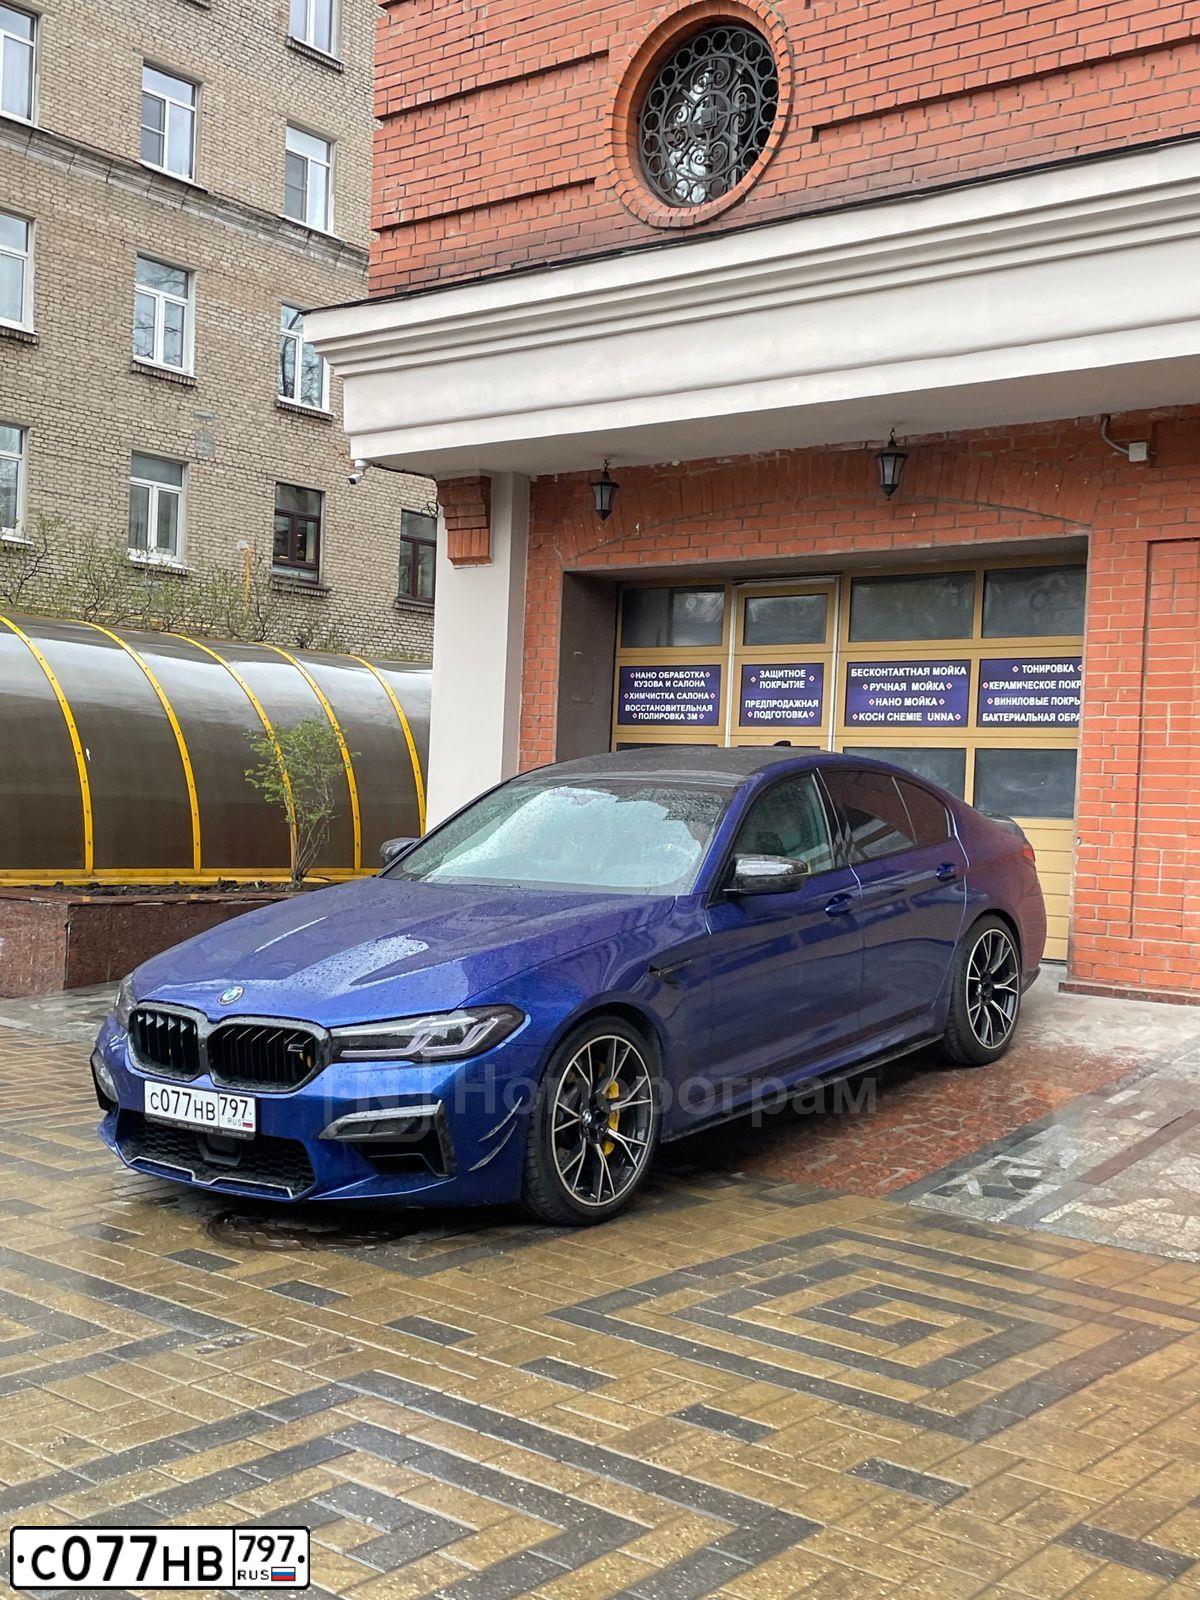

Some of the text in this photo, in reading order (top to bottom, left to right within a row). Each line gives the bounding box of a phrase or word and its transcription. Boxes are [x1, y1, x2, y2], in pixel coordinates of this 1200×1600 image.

[851, 665, 967, 677] БЕСКОНТАКТНАЯ МОЙКА
[1022, 664, 1075, 674] ТОНИРОВКА
[635, 671, 705, 679] НАНО ОБРАБОТКА
[759, 669, 806, 679] ЗАЩИТНОЕ
[634, 680, 706, 688] КУЗОВА И САЛОНА
[759, 680, 805, 689] ПОКРЫТИЕ
[869, 681, 945, 691] РУЧНАЯ МОЙКА
[989, 681, 1057, 690] КЕРАМИЧЕСКОЕ
[629, 692, 710, 700] ХИМЧИСТКА САЛОНА
[745, 699, 819, 709] ПРЕДПРОДАЖНАЯ
[875, 696, 937, 706] НАНО МОЙКА
[994, 697, 1049, 706] ВИНИЛОВЫЕ
[625, 704, 713, 712] ВОССТАНОВИТЕЛЬНАЯ
[753, 711, 809, 720] ПОДГОТОВКА
[858, 712, 955, 721] KOCH CHEMIE UNNA
[982, 713, 1056, 722] БАКТЕРИАЛЬНАЯ
[219, 1096, 249, 1119] 797
